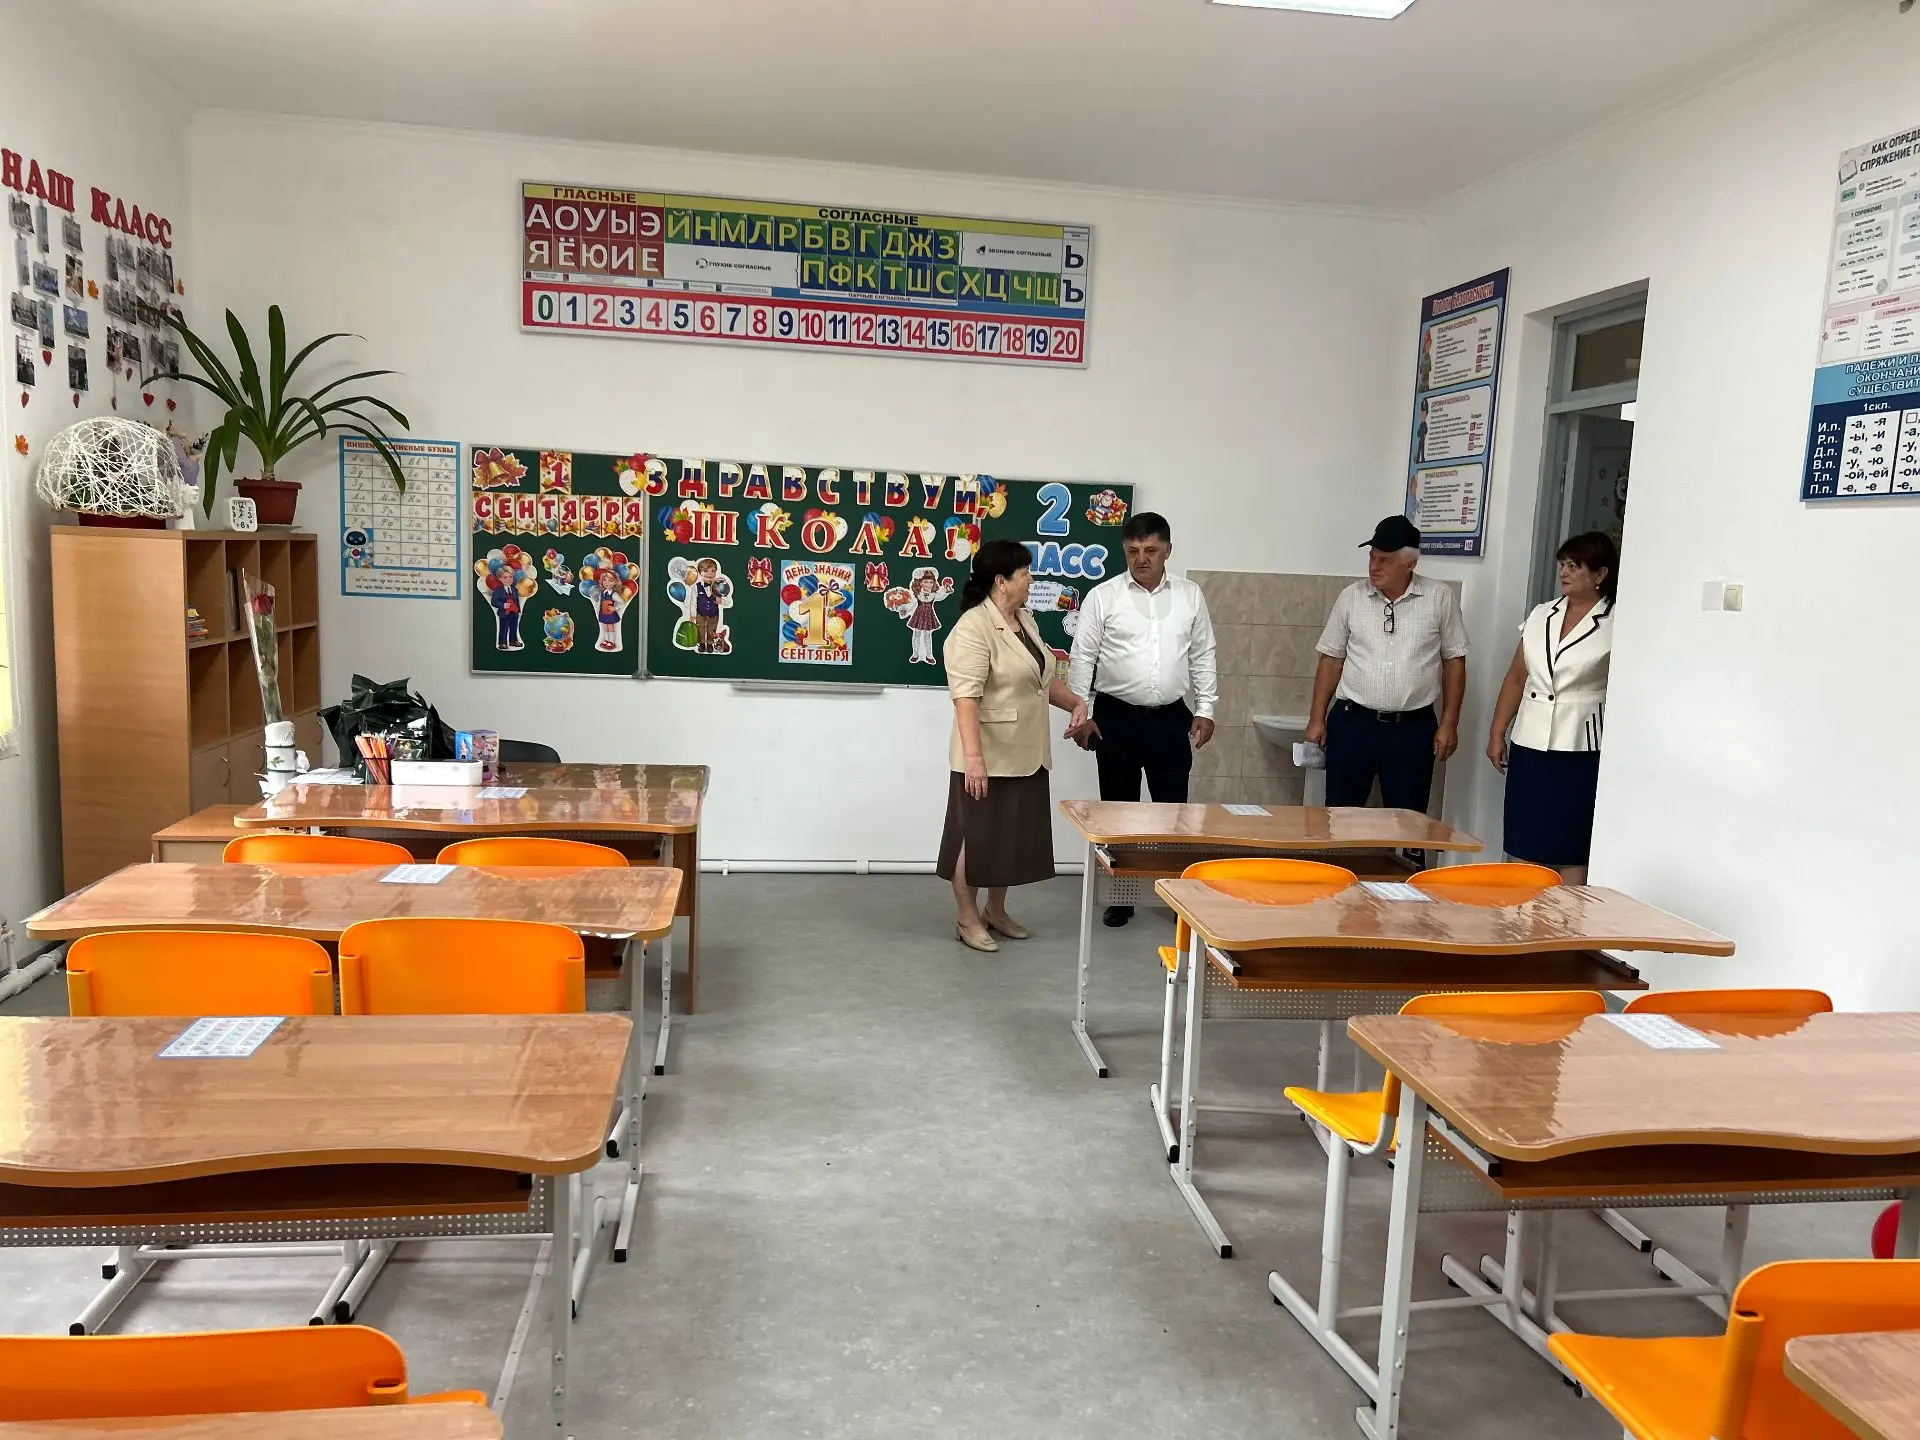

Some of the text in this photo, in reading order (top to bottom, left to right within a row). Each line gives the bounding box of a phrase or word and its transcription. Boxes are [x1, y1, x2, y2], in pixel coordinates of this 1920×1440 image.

[1871, 139, 1888, 154] КАК
[1860, 146, 1912, 172] СПРЯЖЕНИЕ
[0, 147, 172, 250] НАШ КЛАСС
[553, 187, 636, 204] ГЛАСНЫЕ
[818, 208, 919, 226] СОГЛАСНЫЕ
[537, 294, 1077, 355] 0 1 2 3 4 5 6 7 8 9 10 11 12 13 14 15 16 17 18 19 20
[1845, 353, 1920, 374] ПАДЕЖИ И П
[1856, 366, 1920, 383] ОКОНЧАНИ
[1848, 378, 1919, 396] СУЩЕСТВИТ
[1818, 422, 1841, 433] И.п.
[1817, 435, 1838, 445] Р.п.
[1814, 447, 1838, 459] Д.п.
[1813, 460, 1836, 470] В.п.
[551, 461, 563, 489] 1
[1813, 472, 1833, 482] Т.п.
[1810, 484, 1833, 495] П.п.
[475, 495, 641, 523] СЕНТЯБРЯ
[1037, 482, 1072, 536] 2
[690, 509, 959, 560] ШКОЛА!
[785, 564, 810, 581] ДЕНЬ
[799, 591, 830, 646] 1
[780, 648, 849, 662] СЕНТЯБРЯ
